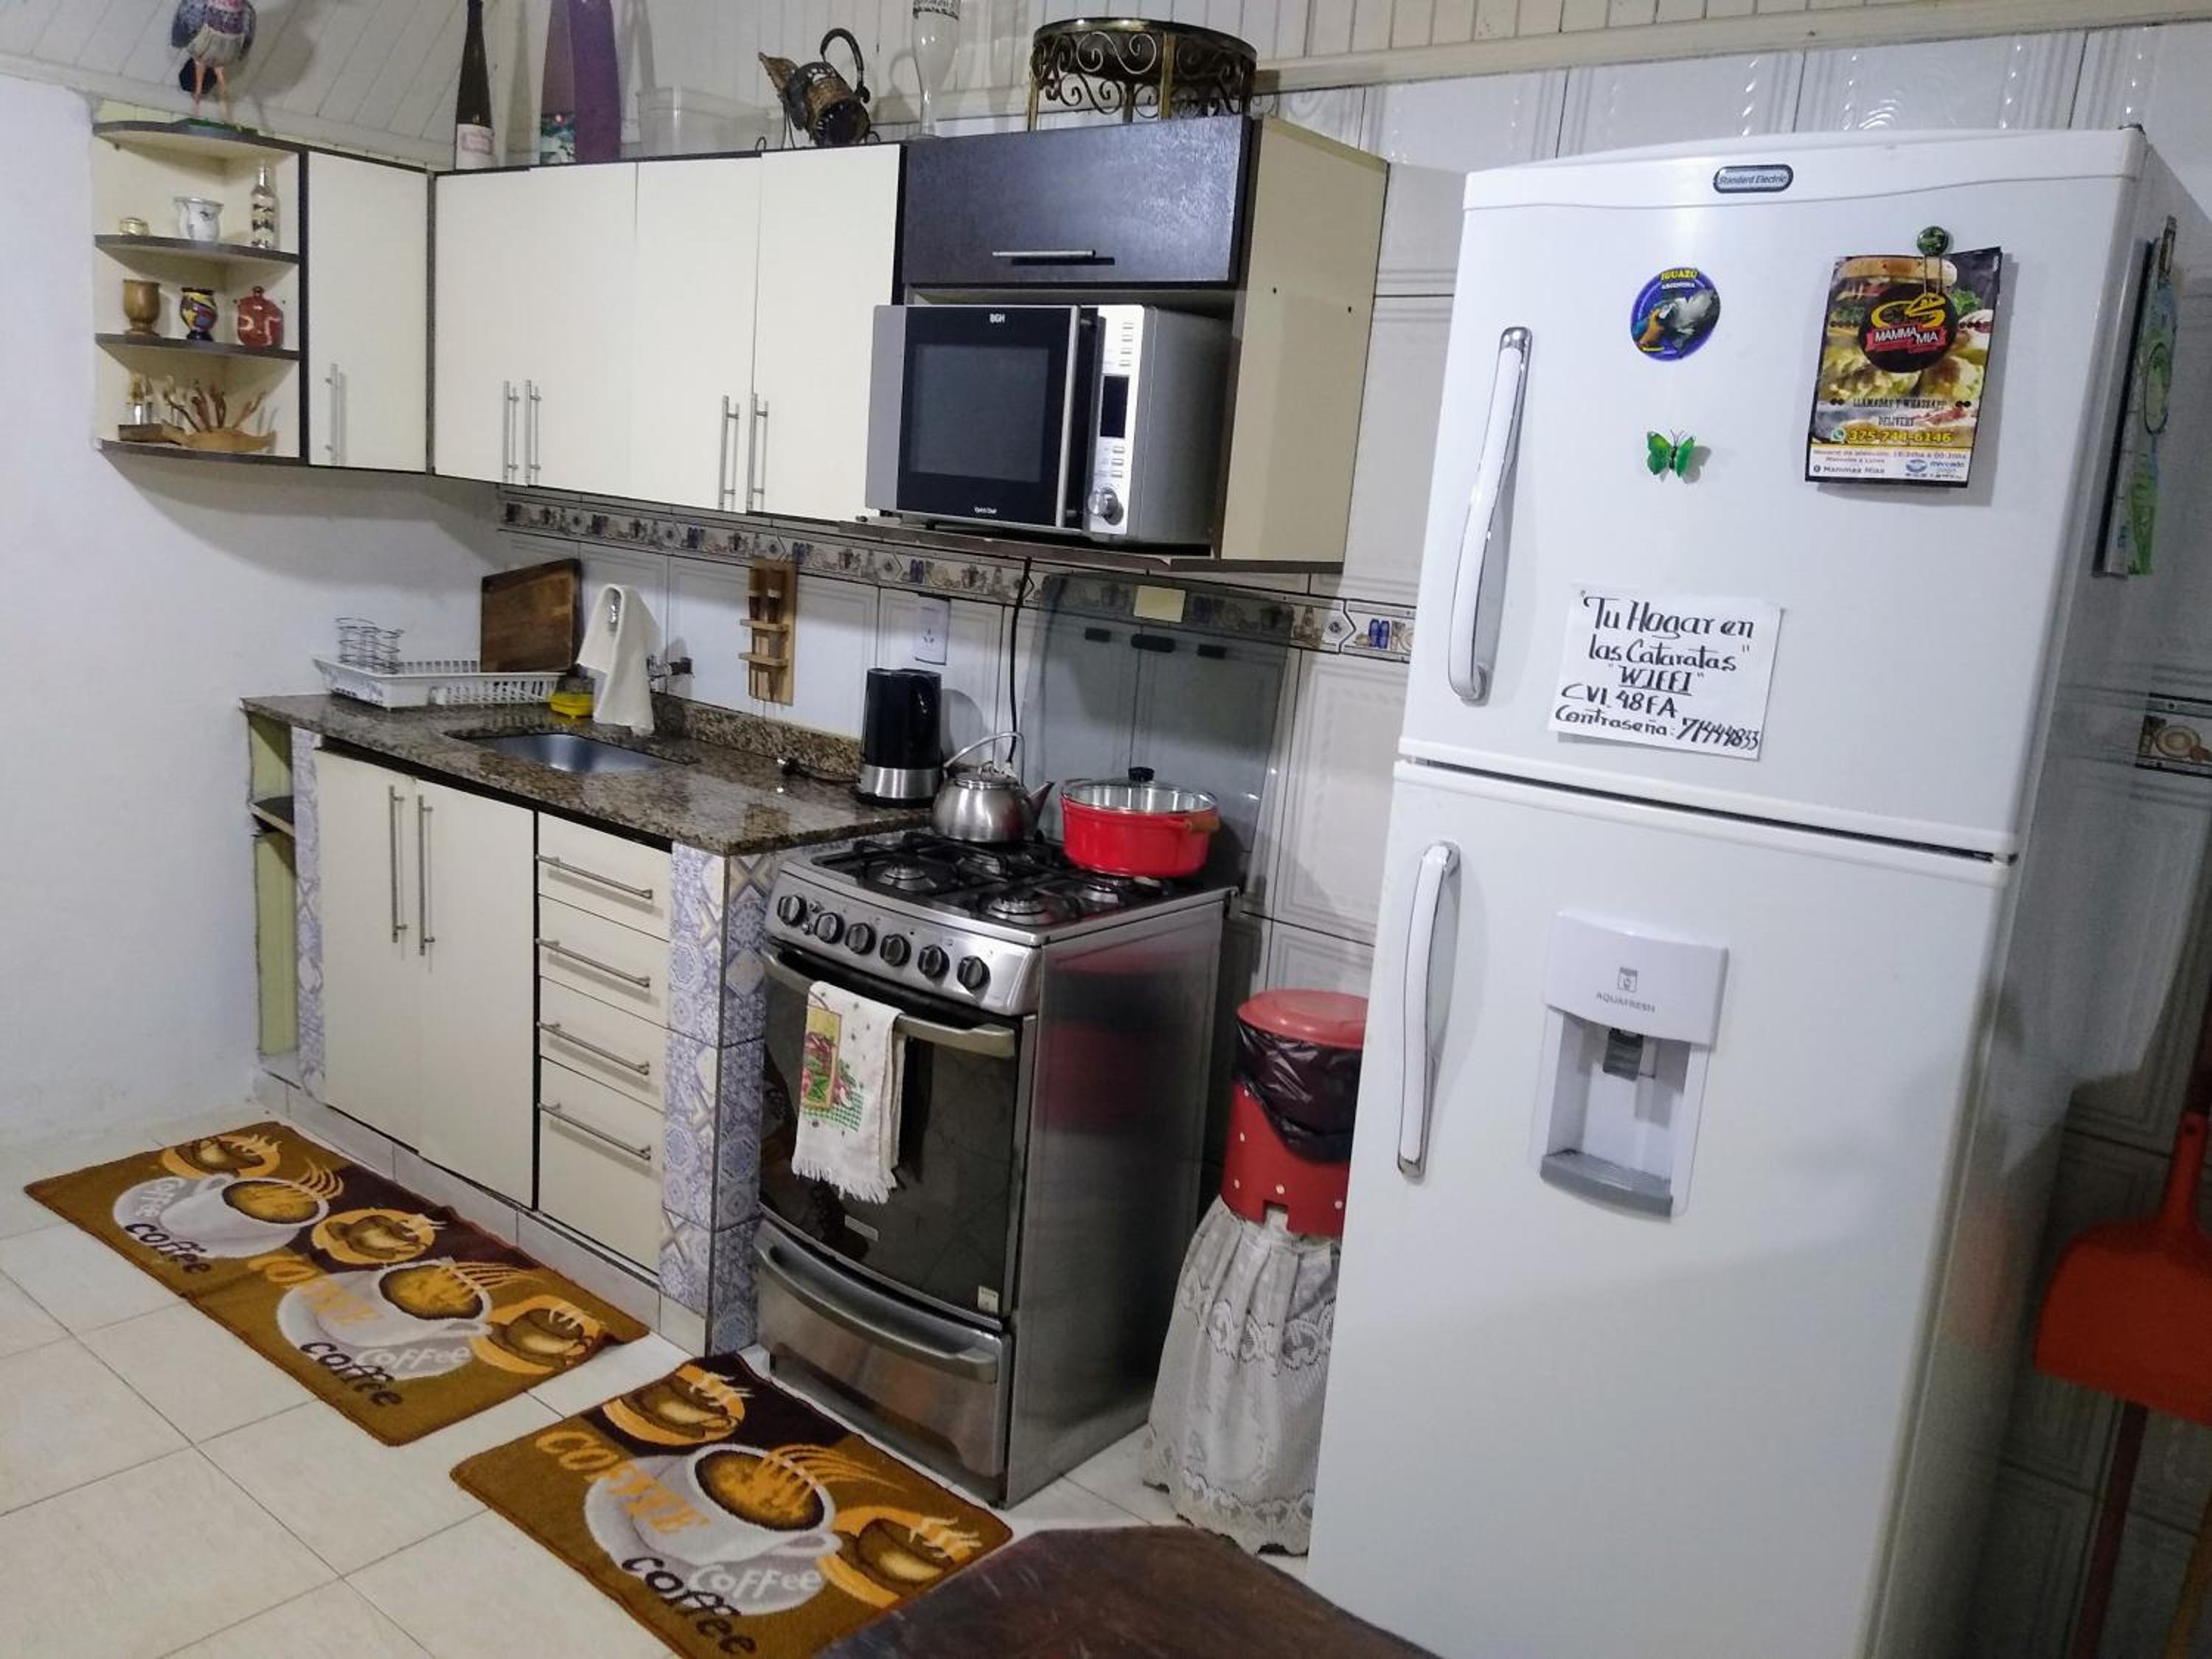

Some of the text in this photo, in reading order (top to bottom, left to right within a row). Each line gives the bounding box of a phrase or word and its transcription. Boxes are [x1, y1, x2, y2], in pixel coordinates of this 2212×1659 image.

[1756, 174, 1787, 184] Electric
[1875, 327, 1938, 344] MAMMA MIA
[1848, 430, 1877, 441] 375
[1626, 600, 1716, 640] Hogar
[1720, 620, 1755, 639] en
[1589, 633, 1622, 662] las
[1596, 990, 1656, 1014] AQUAFRESH
[125, 1222, 212, 1274] coffee
[299, 1341, 403, 1407] coffee
[621, 1557, 757, 1655] coffee
